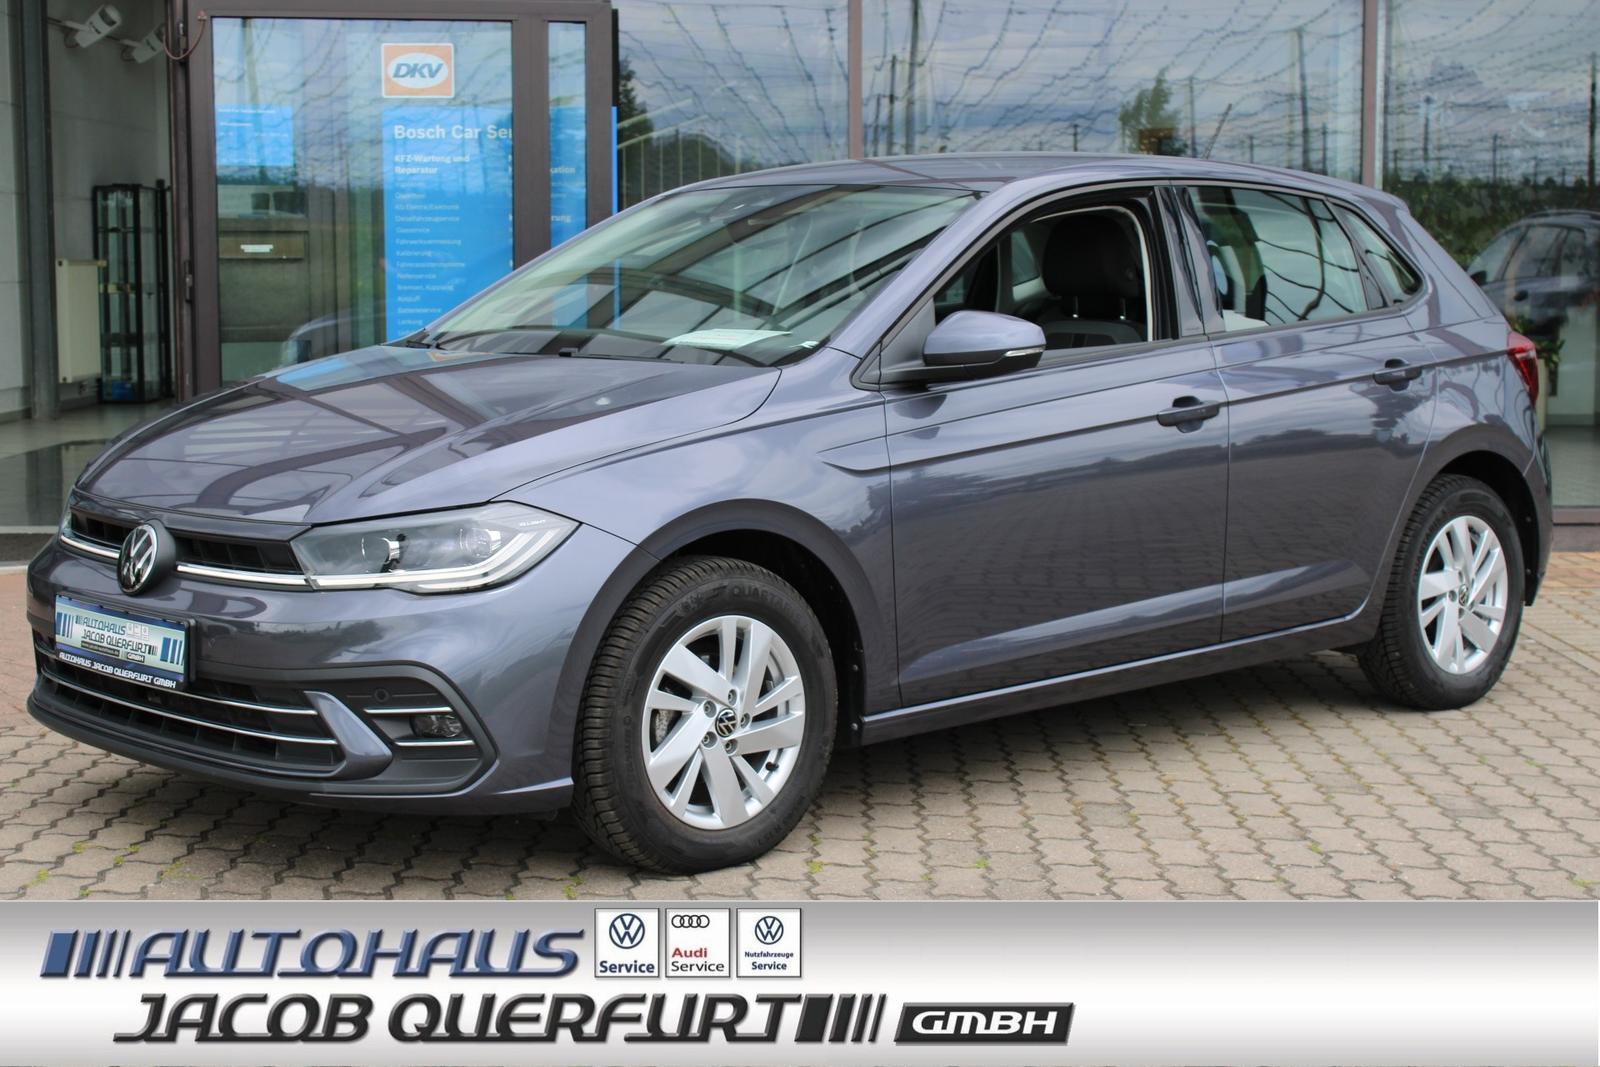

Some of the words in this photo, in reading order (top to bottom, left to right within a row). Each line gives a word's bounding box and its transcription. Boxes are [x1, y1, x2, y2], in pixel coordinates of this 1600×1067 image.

[391, 62, 444, 79] DKV
[393, 124, 446, 140] Bosch
[451, 124, 481, 140] Car
[452, 153, 471, 164] und
[394, 166, 439, 176] Reparatur
[81, 615, 127, 637] AUTOHAUS
[81, 628, 106, 644] JACOB
[105, 634, 150, 655] QUERFURT
[59, 651, 92, 668] AUTOHAUS
[91, 660, 114, 676] JACOB
[113, 666, 154, 684] QUERFURT
